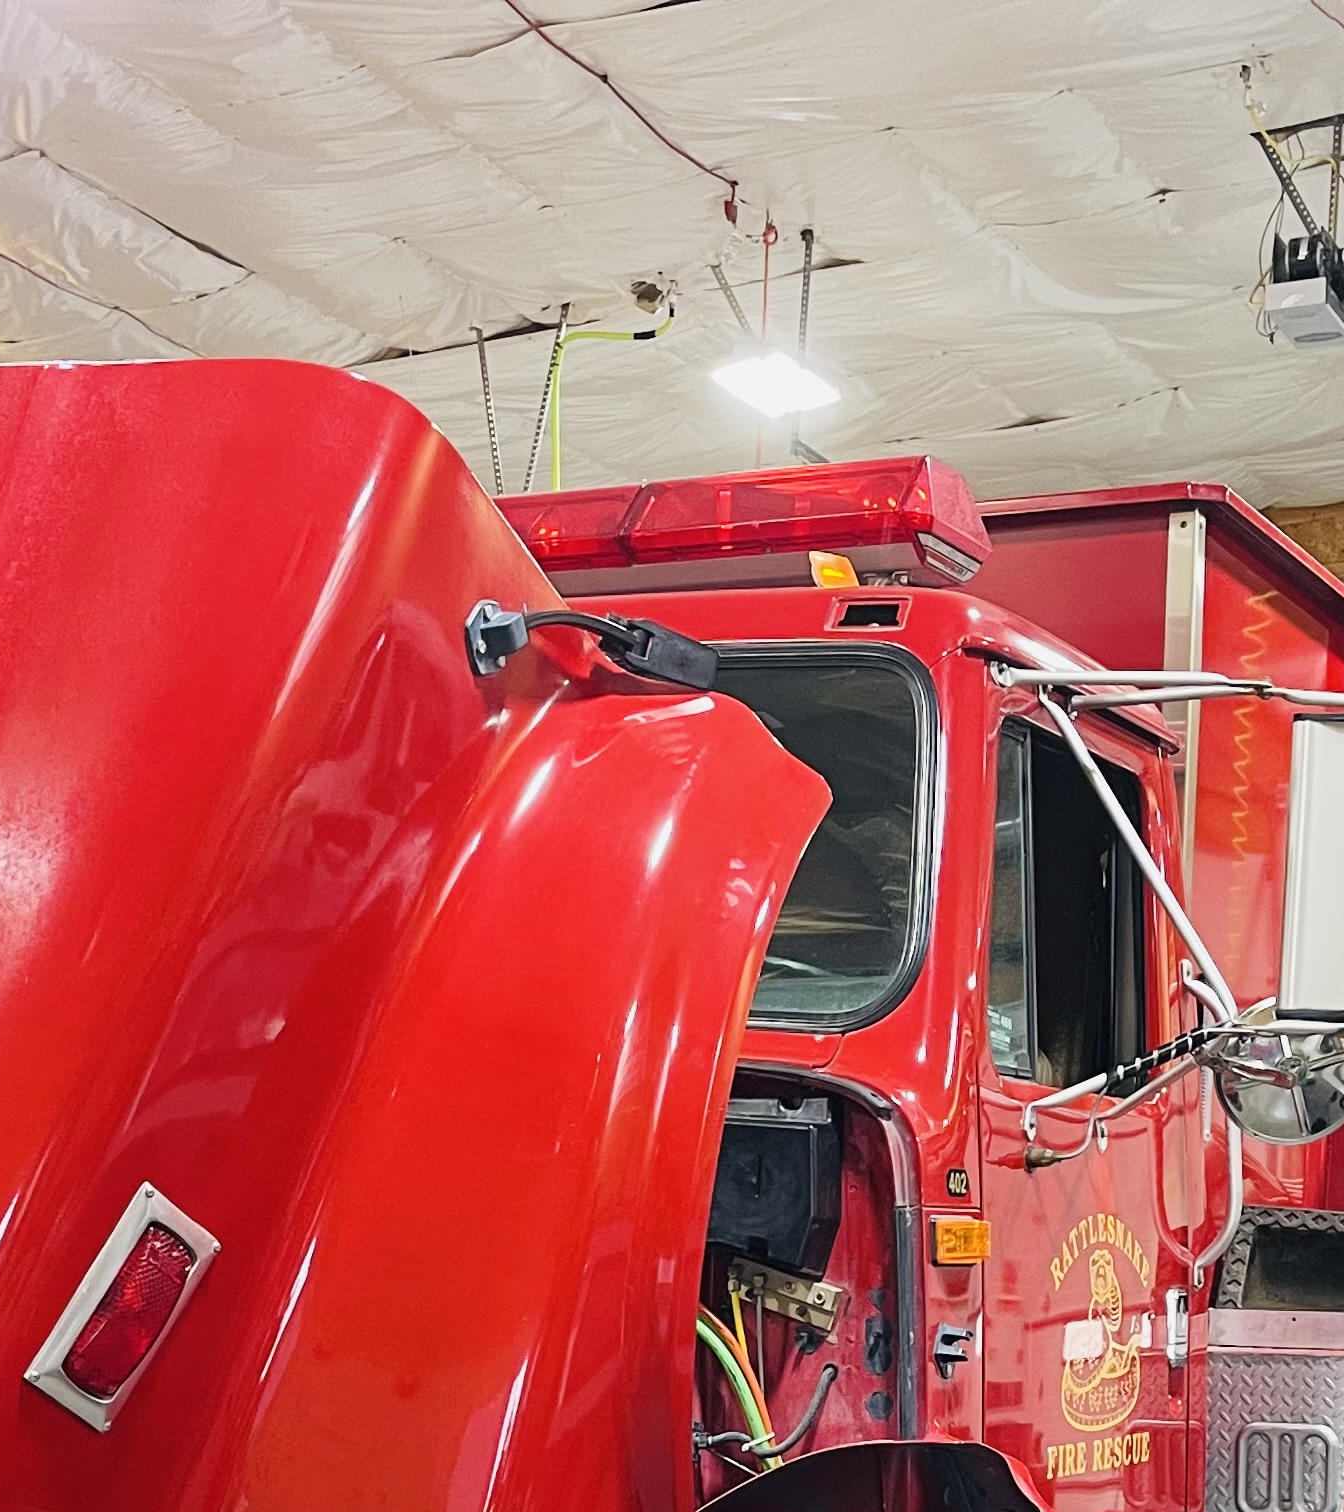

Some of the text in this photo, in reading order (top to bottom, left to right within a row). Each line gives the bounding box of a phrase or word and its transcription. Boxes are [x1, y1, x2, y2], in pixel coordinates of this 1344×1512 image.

[948, 1172, 968, 1194] 402
[1049, 1212, 1151, 1292] RATTLESNAKE
[1046, 1431, 1151, 1480] FIRE RESCUE
